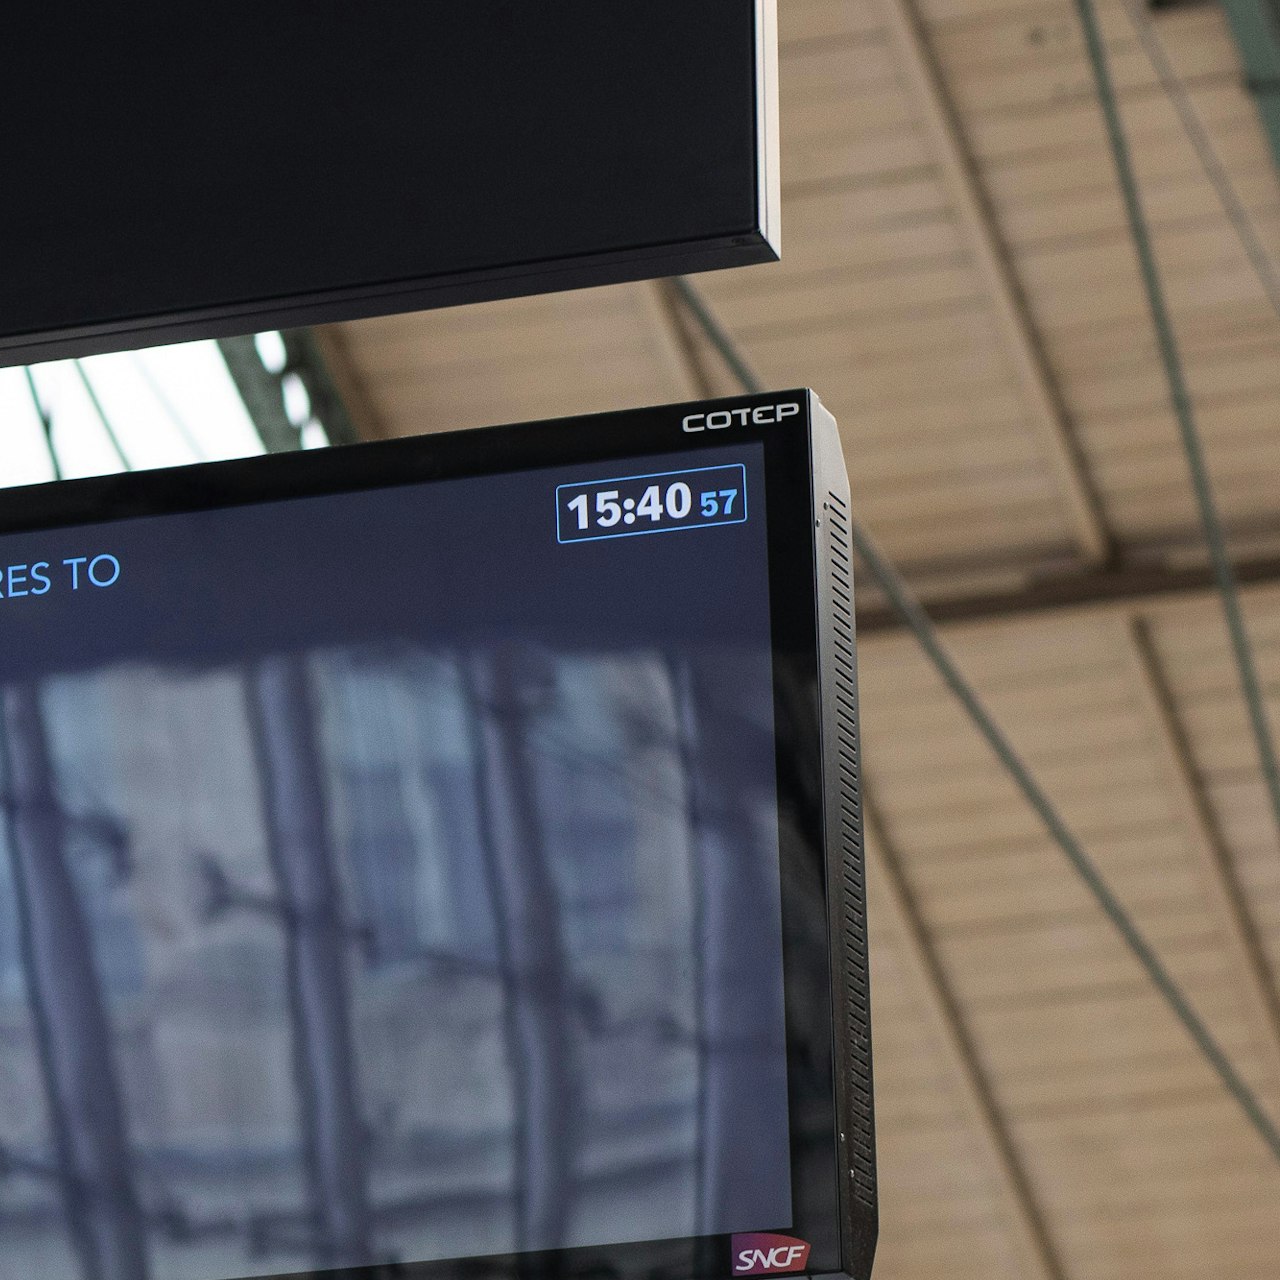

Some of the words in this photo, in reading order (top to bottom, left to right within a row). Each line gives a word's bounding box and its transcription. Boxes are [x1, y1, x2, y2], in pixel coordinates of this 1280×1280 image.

[682, 402, 800, 433] COTEP
[567, 482, 692, 530] 15:40
[700, 488, 738, 517] 57
[62, 553, 120, 590] TO
[735, 1245, 806, 1271] SNCF
